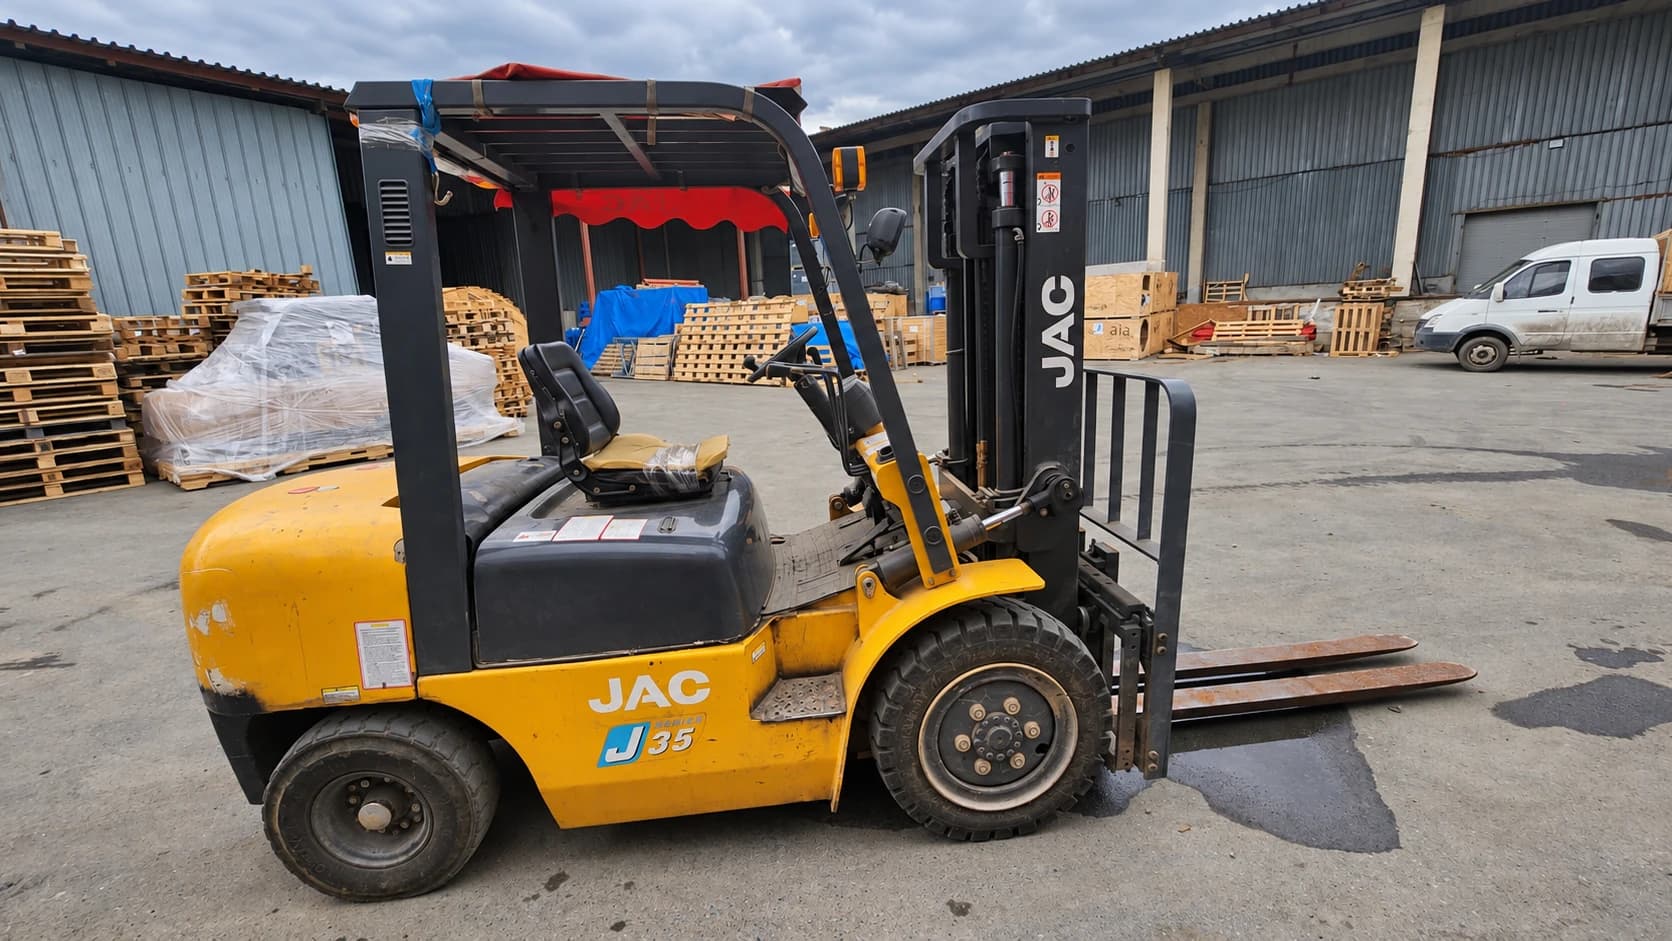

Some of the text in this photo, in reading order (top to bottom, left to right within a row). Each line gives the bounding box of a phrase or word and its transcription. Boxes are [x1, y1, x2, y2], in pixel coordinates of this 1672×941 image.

[1041, 275, 1075, 388] JAC
[588, 670, 711, 714] JAC
[648, 727, 696, 756] 35
